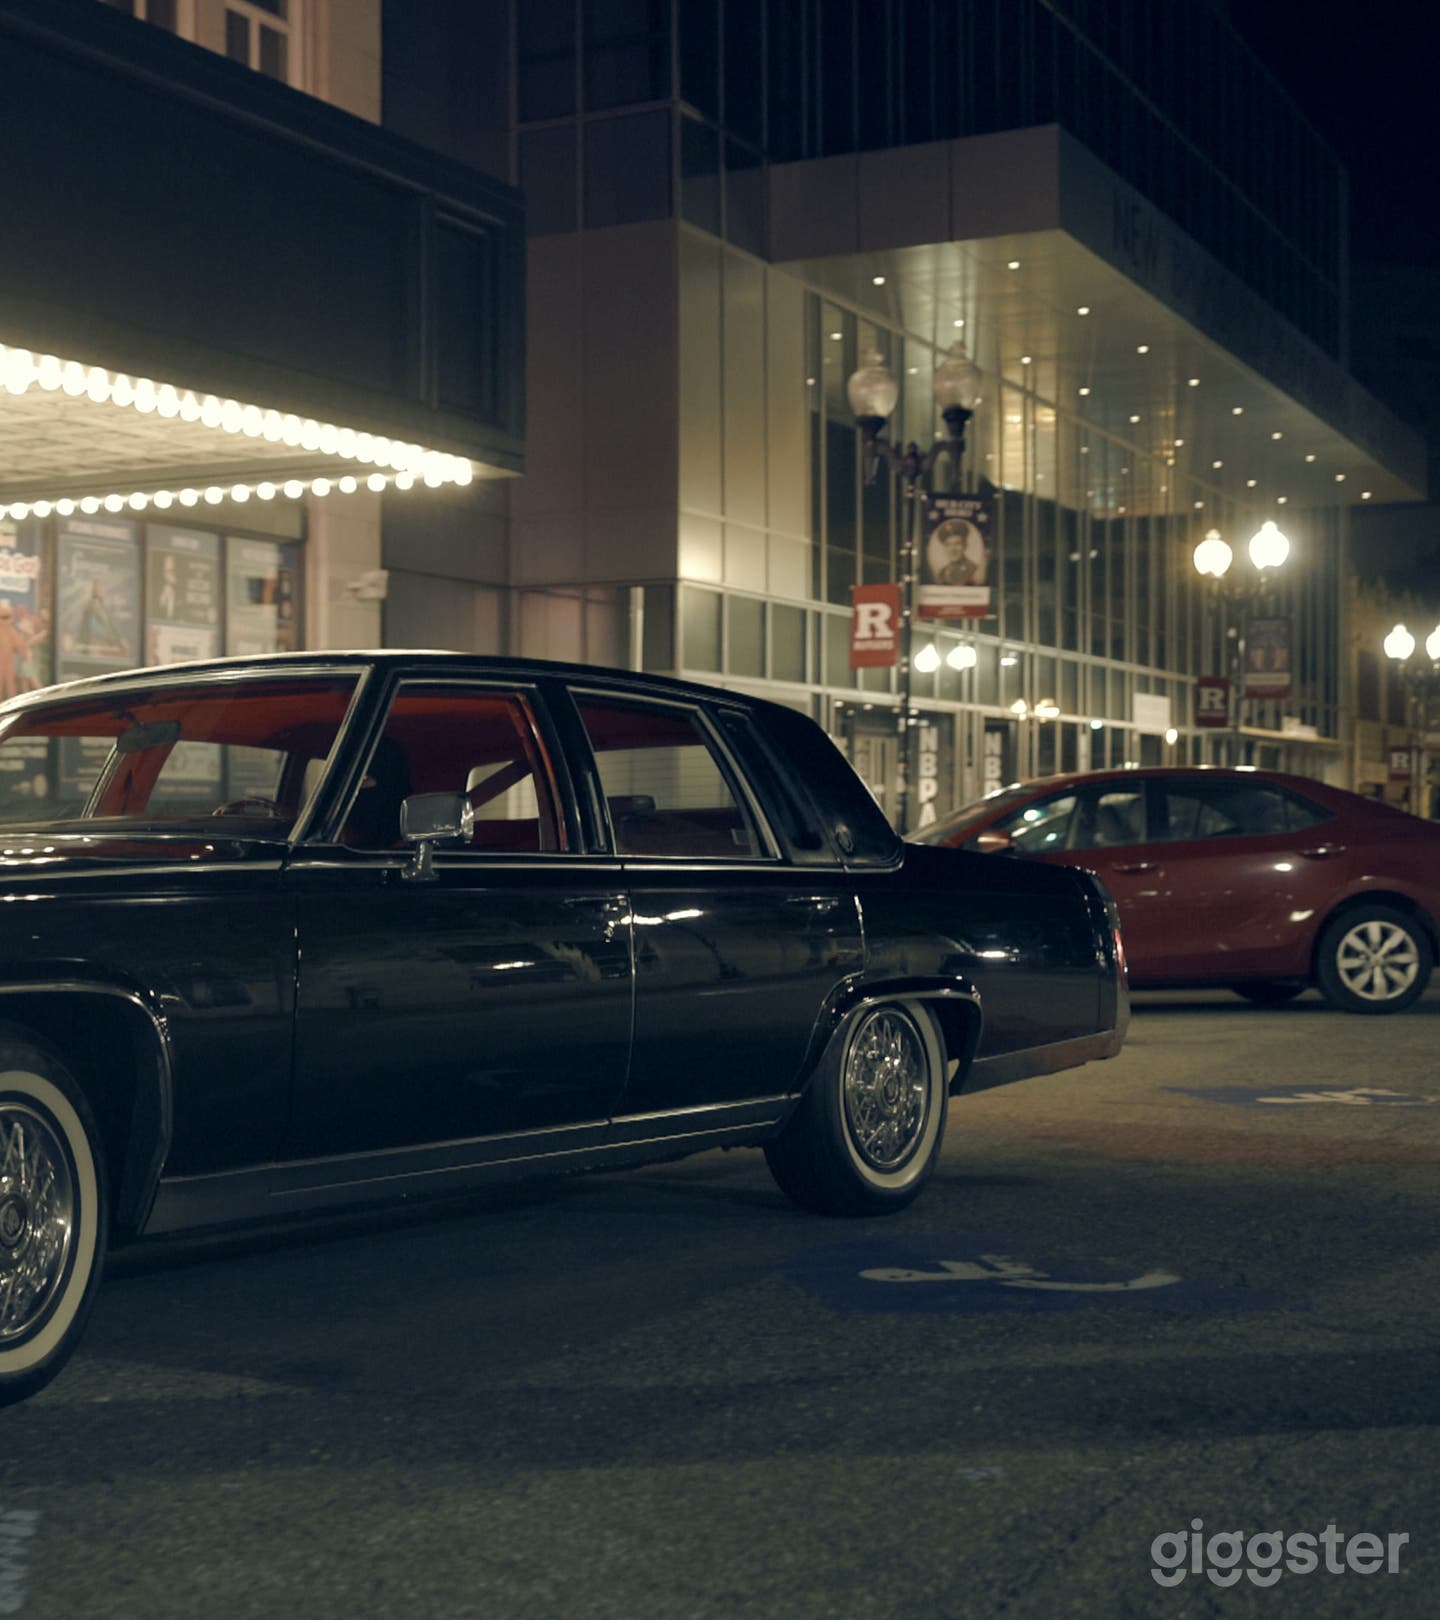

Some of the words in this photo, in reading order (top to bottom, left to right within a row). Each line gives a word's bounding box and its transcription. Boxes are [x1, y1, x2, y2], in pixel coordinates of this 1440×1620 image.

[854, 602, 895, 639] R
[1200, 687, 1226, 710] R
[1391, 751, 1409, 769] R
